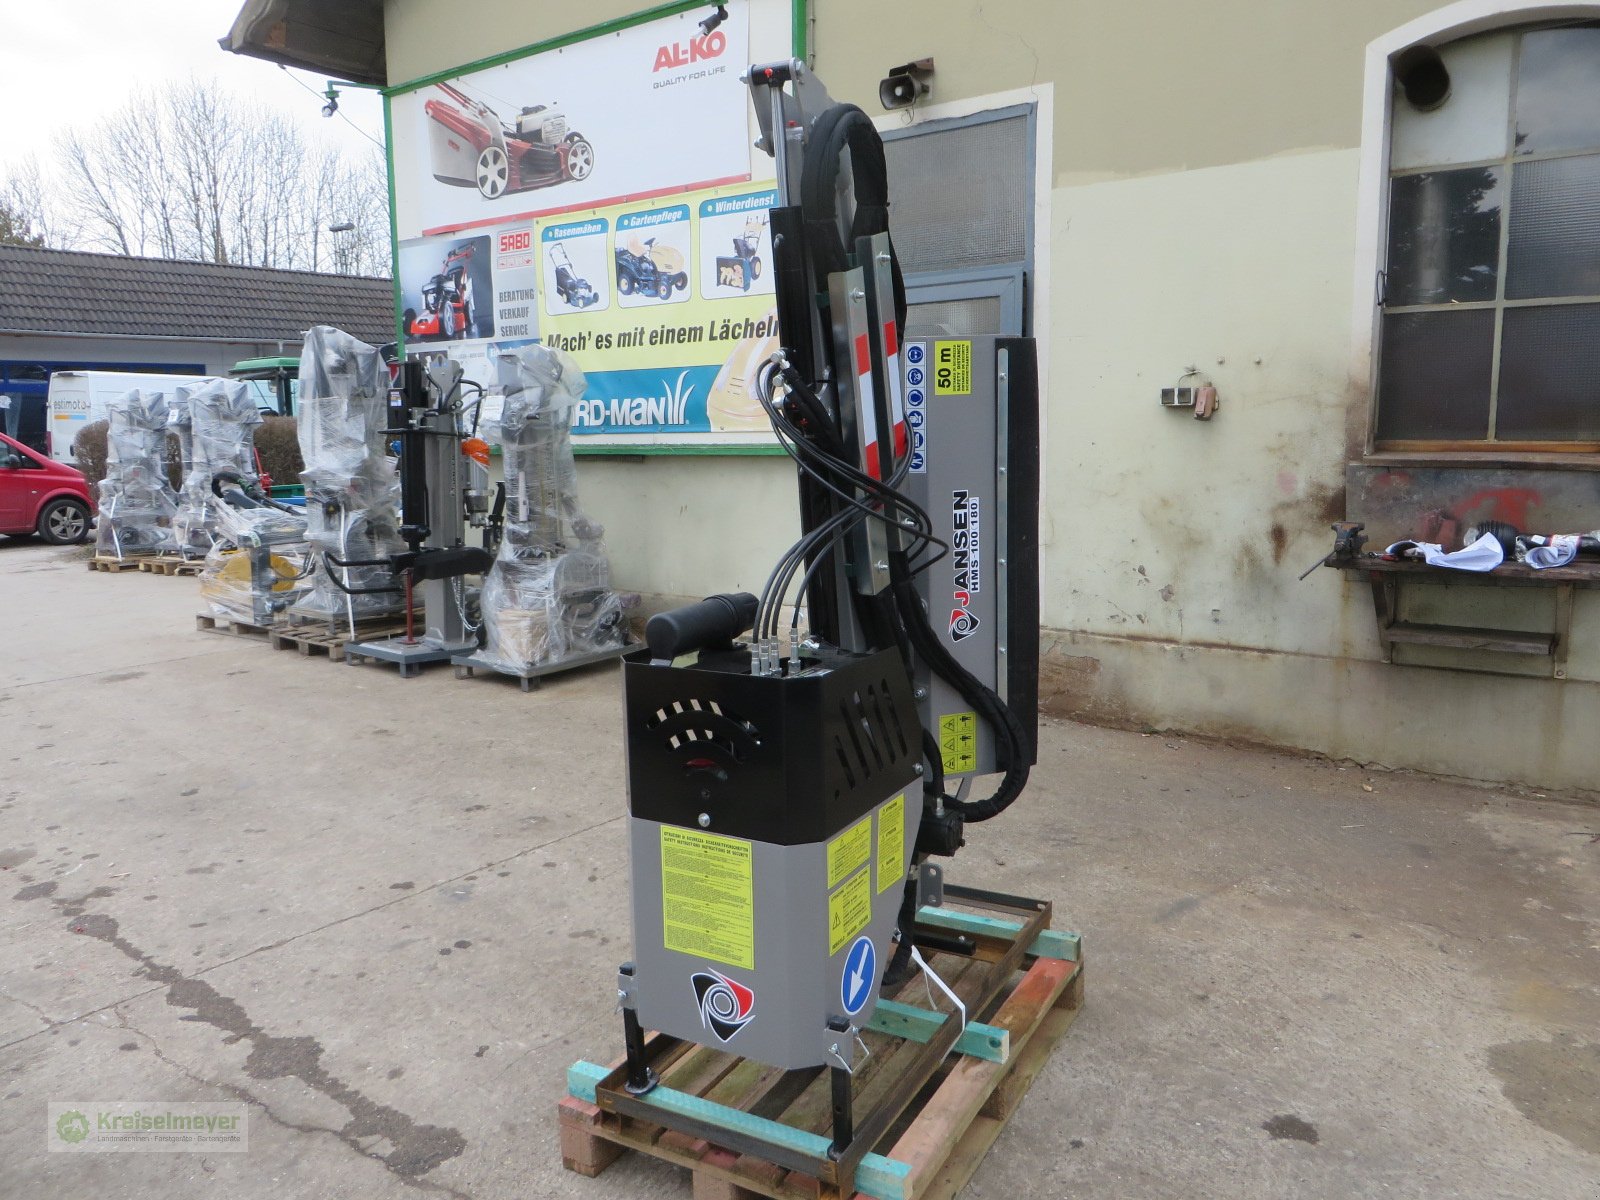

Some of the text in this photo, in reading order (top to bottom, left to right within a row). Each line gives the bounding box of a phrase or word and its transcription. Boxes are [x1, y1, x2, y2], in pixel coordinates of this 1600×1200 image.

[652, 31, 726, 72] AL-KO
[653, 65, 726, 89] QUALITY FOR LIFE
[715, 194, 775, 213] Winterdienst
[630, 209, 683, 227] Gartenpflege
[554, 223, 602, 238] Rasenmähen
[500, 232, 530, 252] SABO
[499, 289, 534, 302] BERATUNG
[499, 307, 529, 320] VERKAUF
[500, 324, 529, 337] SERVICE
[595, 333, 613, 350] es
[617, 327, 646, 347] mit
[649, 324, 704, 346] einem
[937, 347, 951, 388] 50 m
[953, 490, 970, 607] JANSEN
